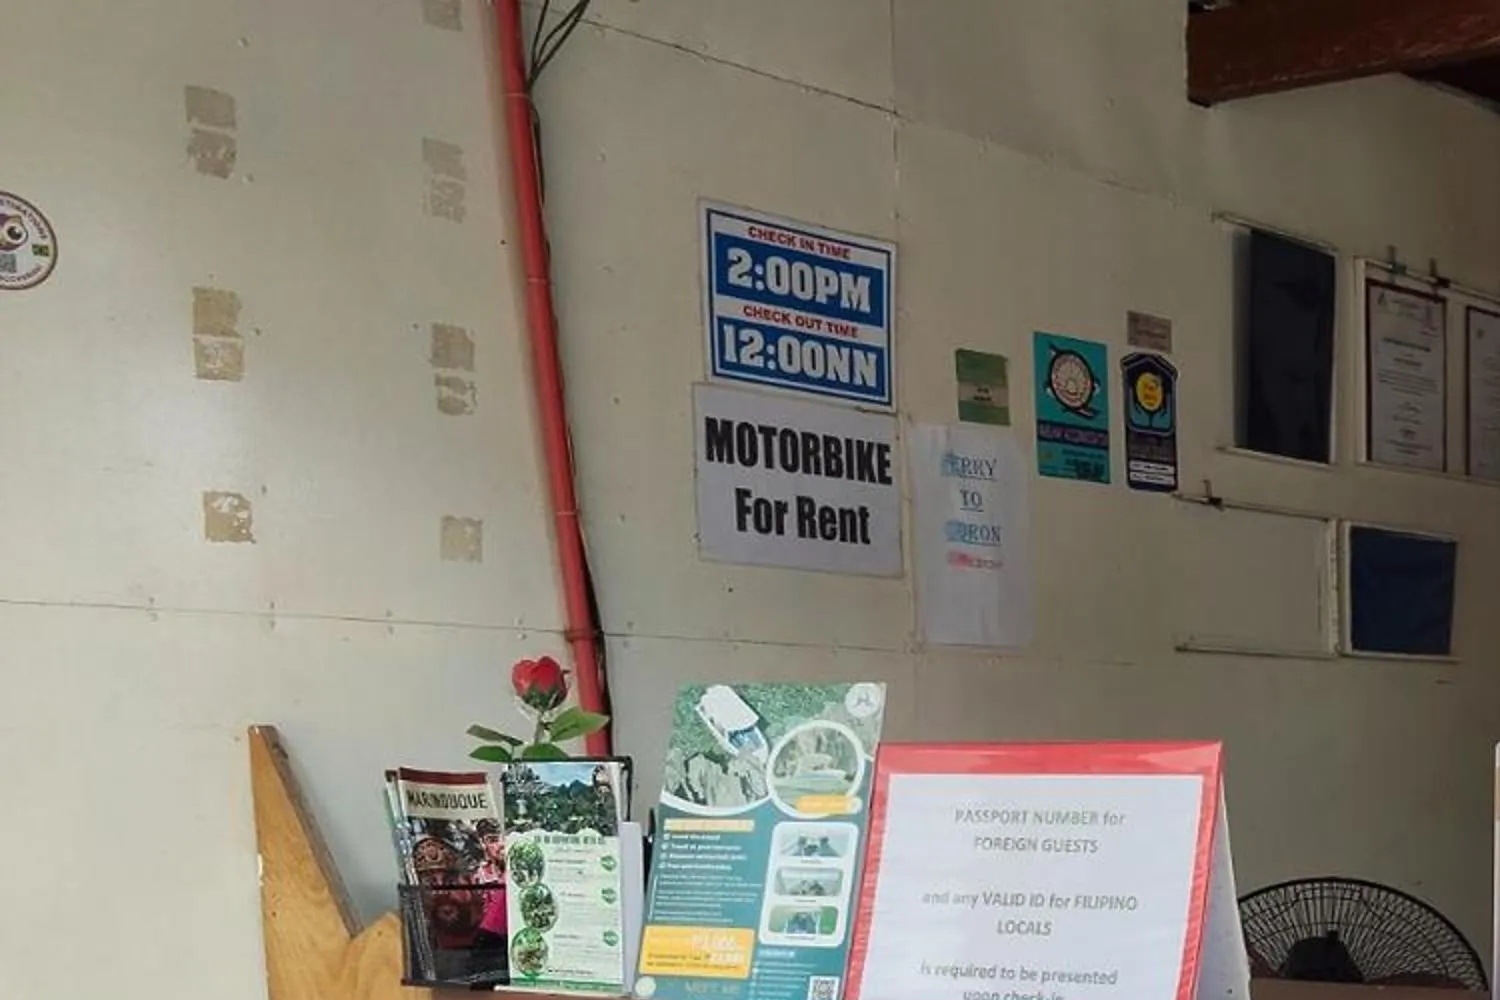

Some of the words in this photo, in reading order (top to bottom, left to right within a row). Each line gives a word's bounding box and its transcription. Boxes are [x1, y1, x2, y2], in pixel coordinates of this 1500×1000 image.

[747, 225, 798, 248] CHECK
[799, 236, 816, 252] IN
[818, 240, 852, 260] TIME
[727, 247, 871, 314] 2:00PM
[743, 305, 793, 327] CHECK
[795, 314, 824, 332] OUT
[825, 318, 858, 339] TIME
[723, 323, 878, 388] 12:00NN
[705, 417, 893, 485] MOTORBIKE
[942, 453, 998, 479] RRY
[959, 489, 984, 509] TO
[734, 488, 789, 537] For
[797, 495, 871, 545] Rent
[946, 521, 1002, 543] ORON
[955, 808, 1029, 824] PASSPORT
[1032, 809, 1099, 826] NUMBER
[1103, 810, 1127, 825] for
[974, 836, 1037, 852] FOREIGN
[1041, 838, 1099, 854] GUESTS
[922, 891, 950, 905] and
[952, 893, 980, 909] any
[982, 890, 1025, 907] VALID
[1029, 892, 1046, 908] ID
[1049, 893, 1071, 910] for
[1074, 894, 1139, 911] FILIPINO
[997, 919, 1053, 936] LOCALS
[934, 962, 997, 982] required
[1000, 965, 1016, 980] to
[1020, 965, 1038, 982] be
[1041, 968, 1119, 987] presented
